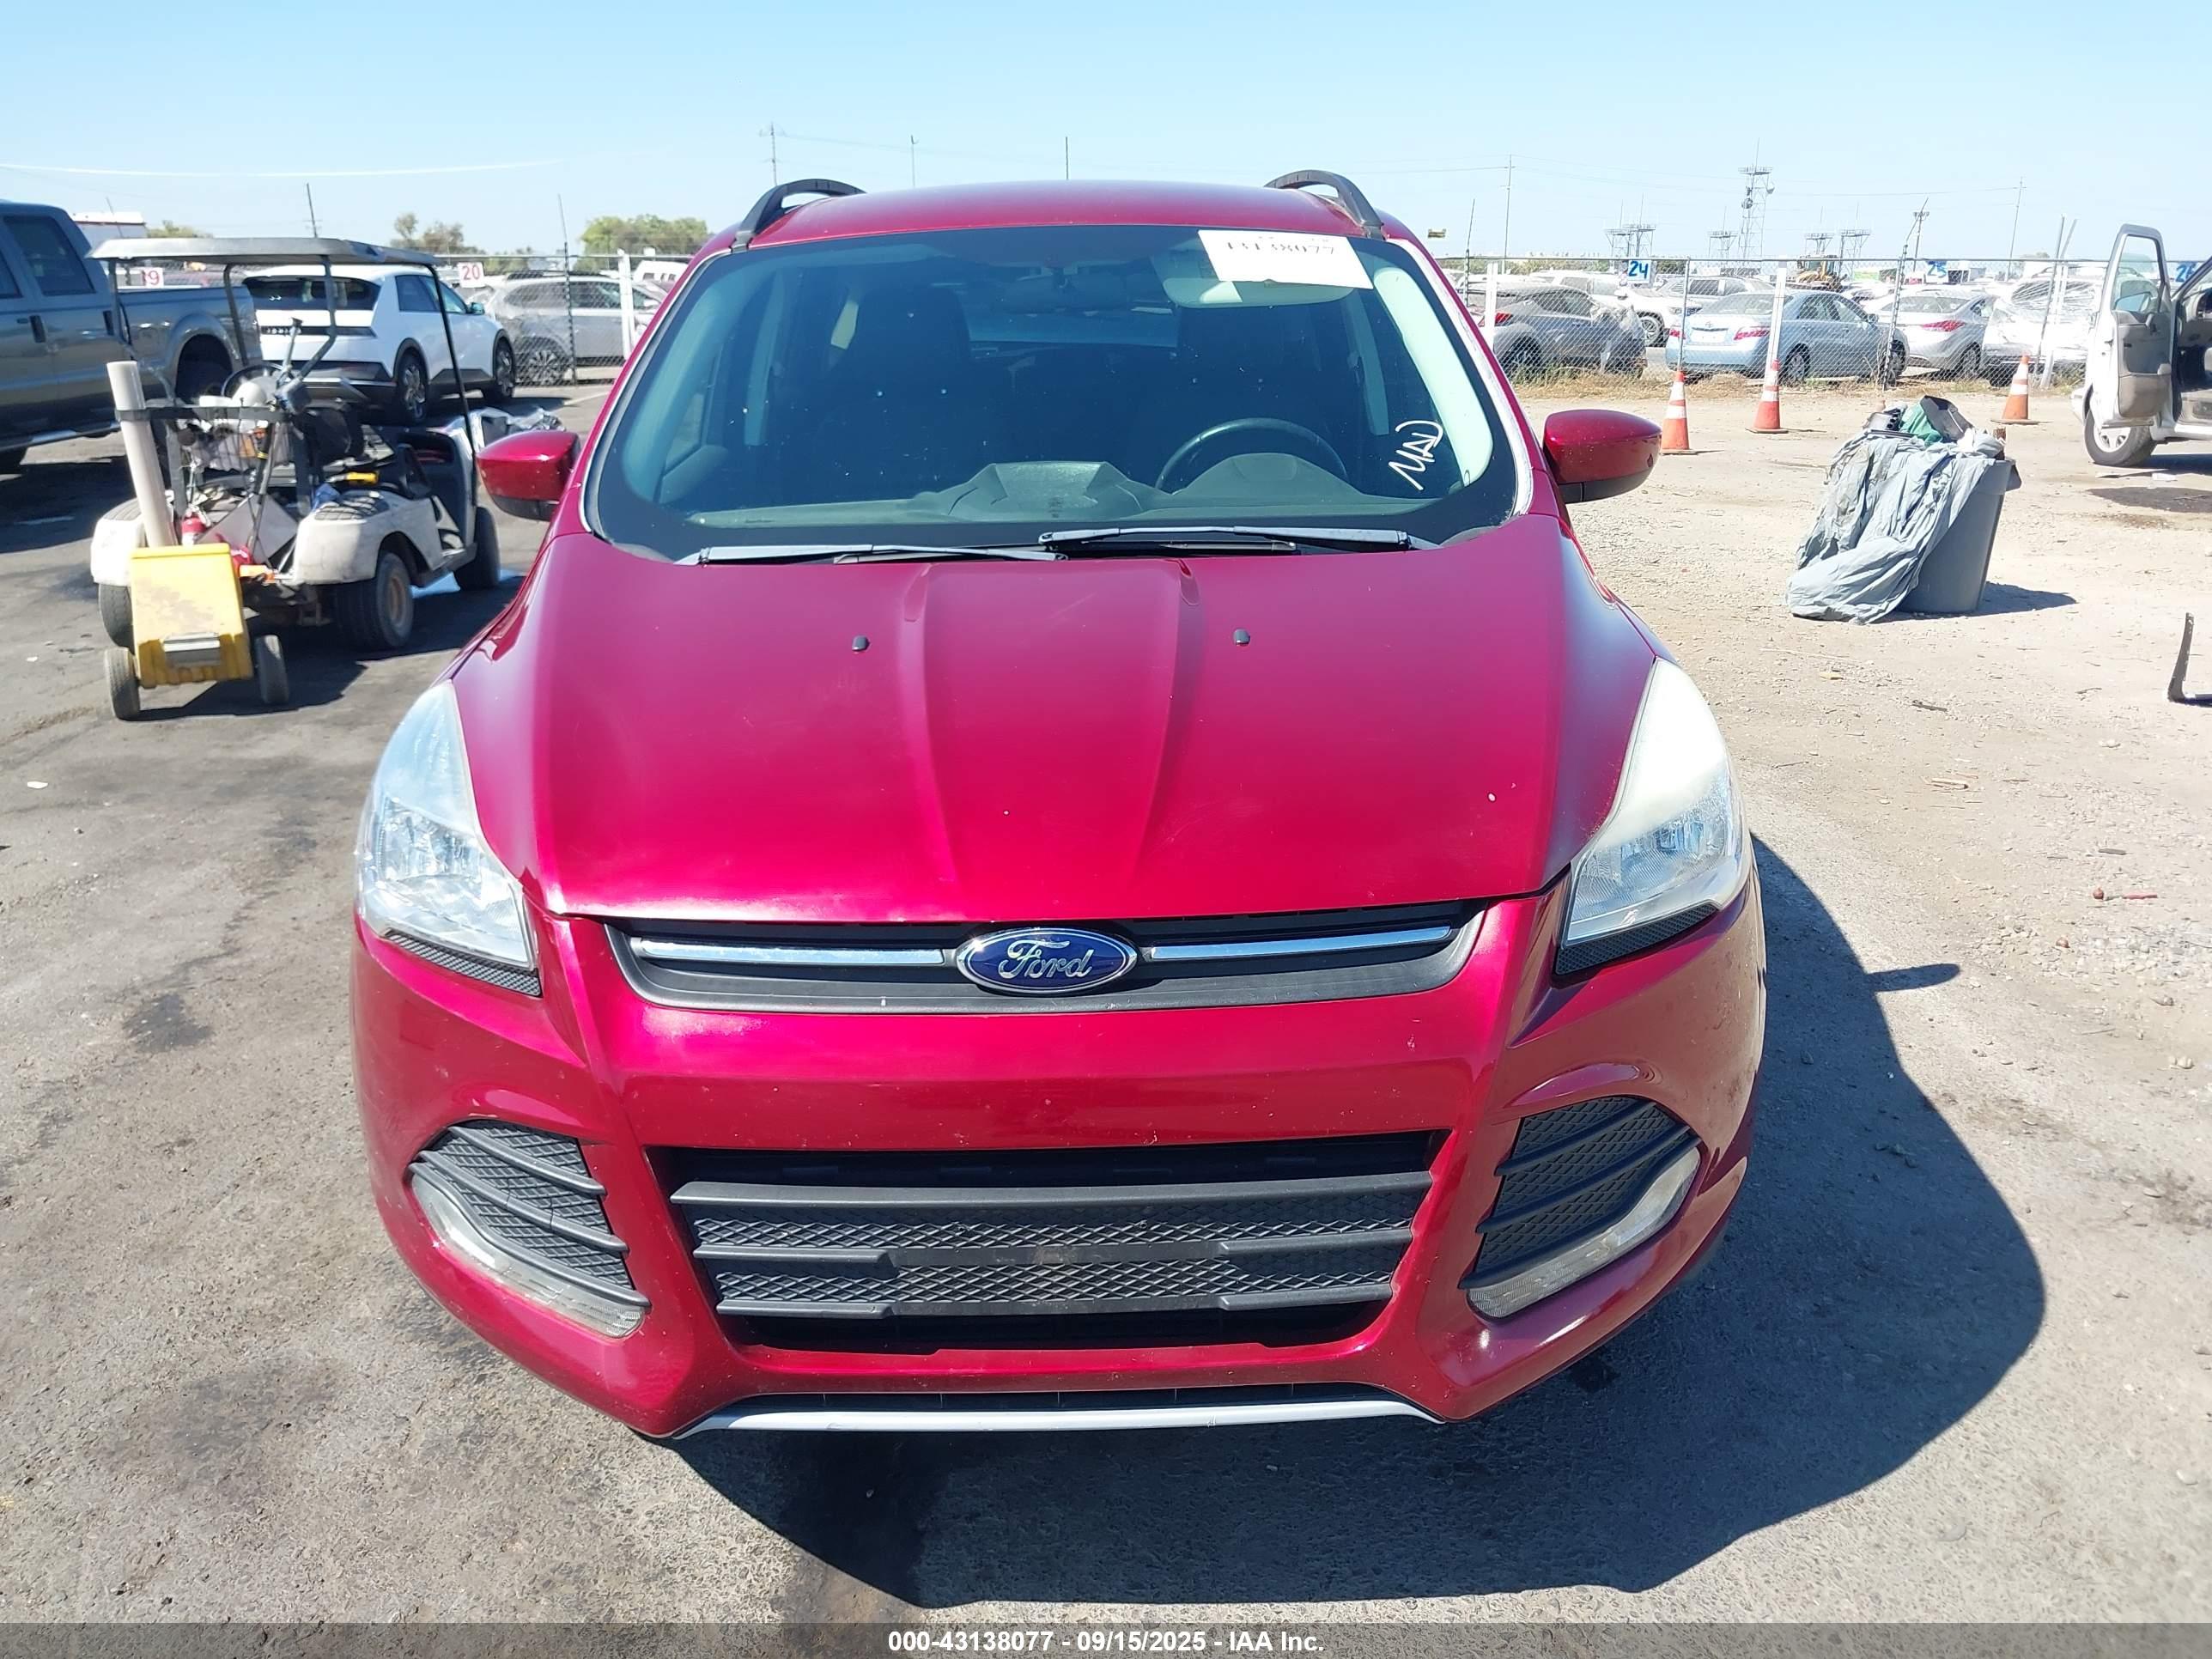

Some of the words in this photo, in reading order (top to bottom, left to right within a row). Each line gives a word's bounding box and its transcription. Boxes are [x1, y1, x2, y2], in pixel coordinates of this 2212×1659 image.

[461, 264, 480, 280] 20
[1628, 260, 1649, 279] 24
[1927, 260, 1947, 278] 25
[998, 939, 1095, 979] Ford
